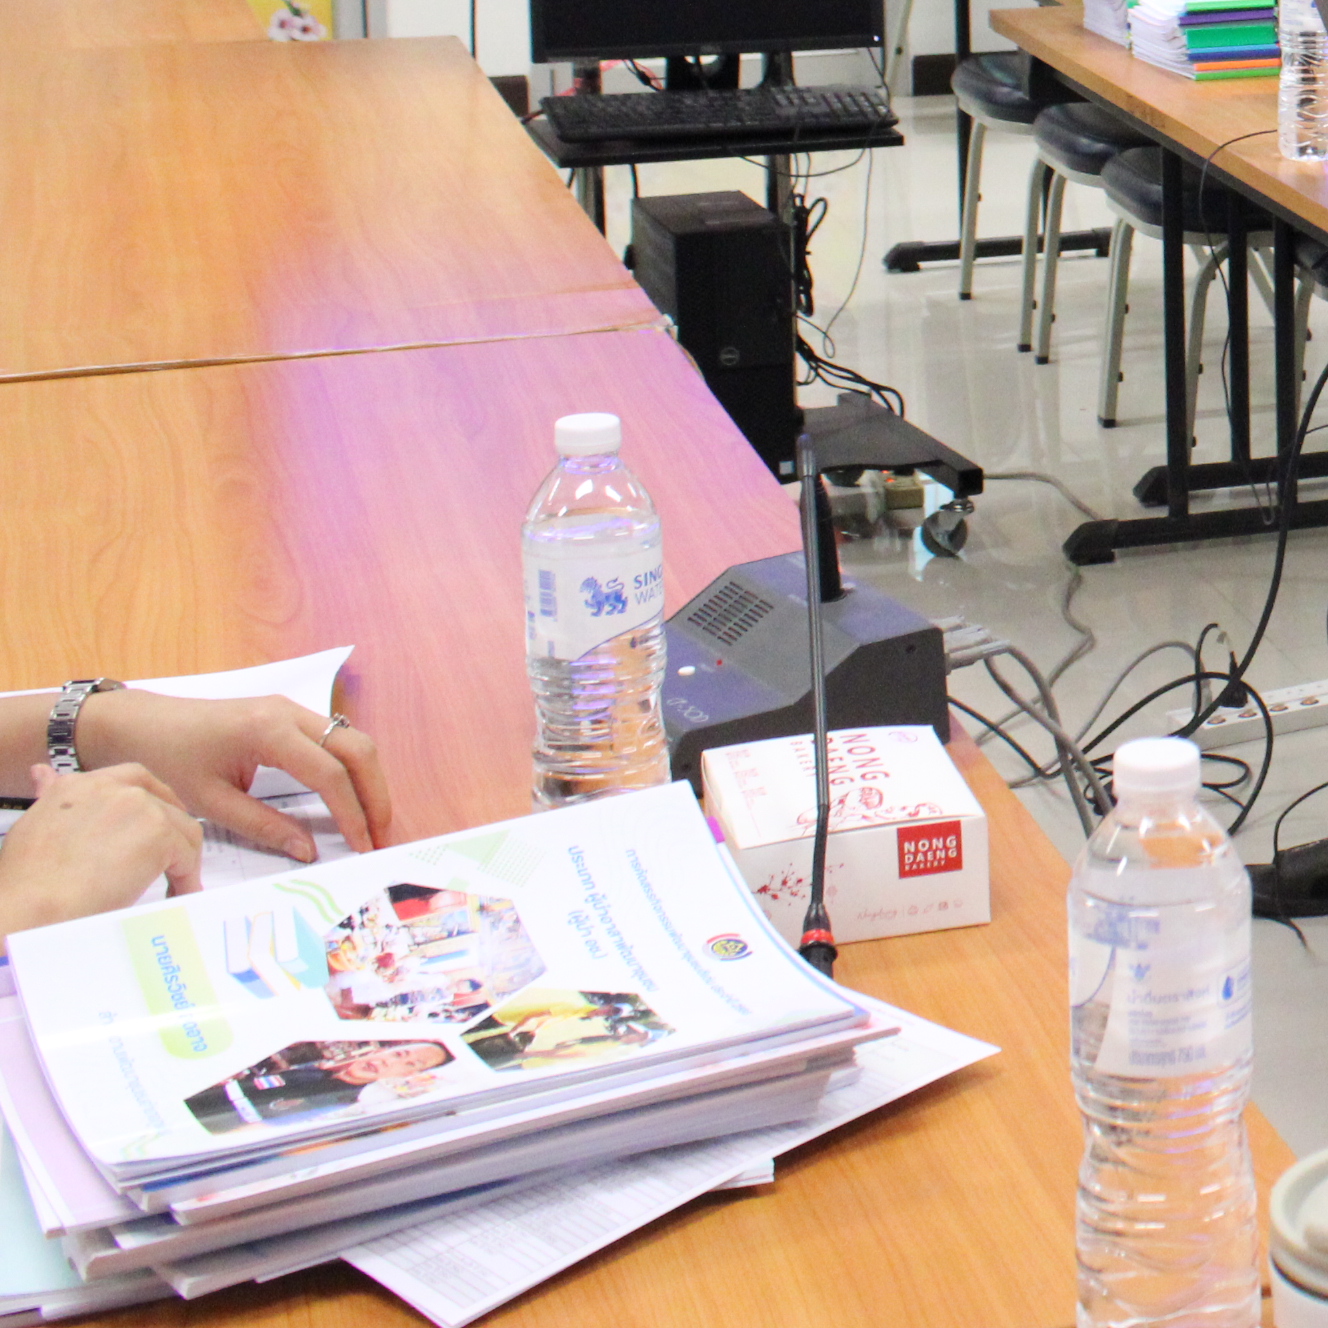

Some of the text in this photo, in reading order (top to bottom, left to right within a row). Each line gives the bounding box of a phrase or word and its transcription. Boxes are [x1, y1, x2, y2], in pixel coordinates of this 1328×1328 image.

[840, 733, 890, 782] NONG
[903, 835, 957, 853] NONG
[904, 847, 958, 864] DAENG
[565, 843, 598, 892] ประเภท
